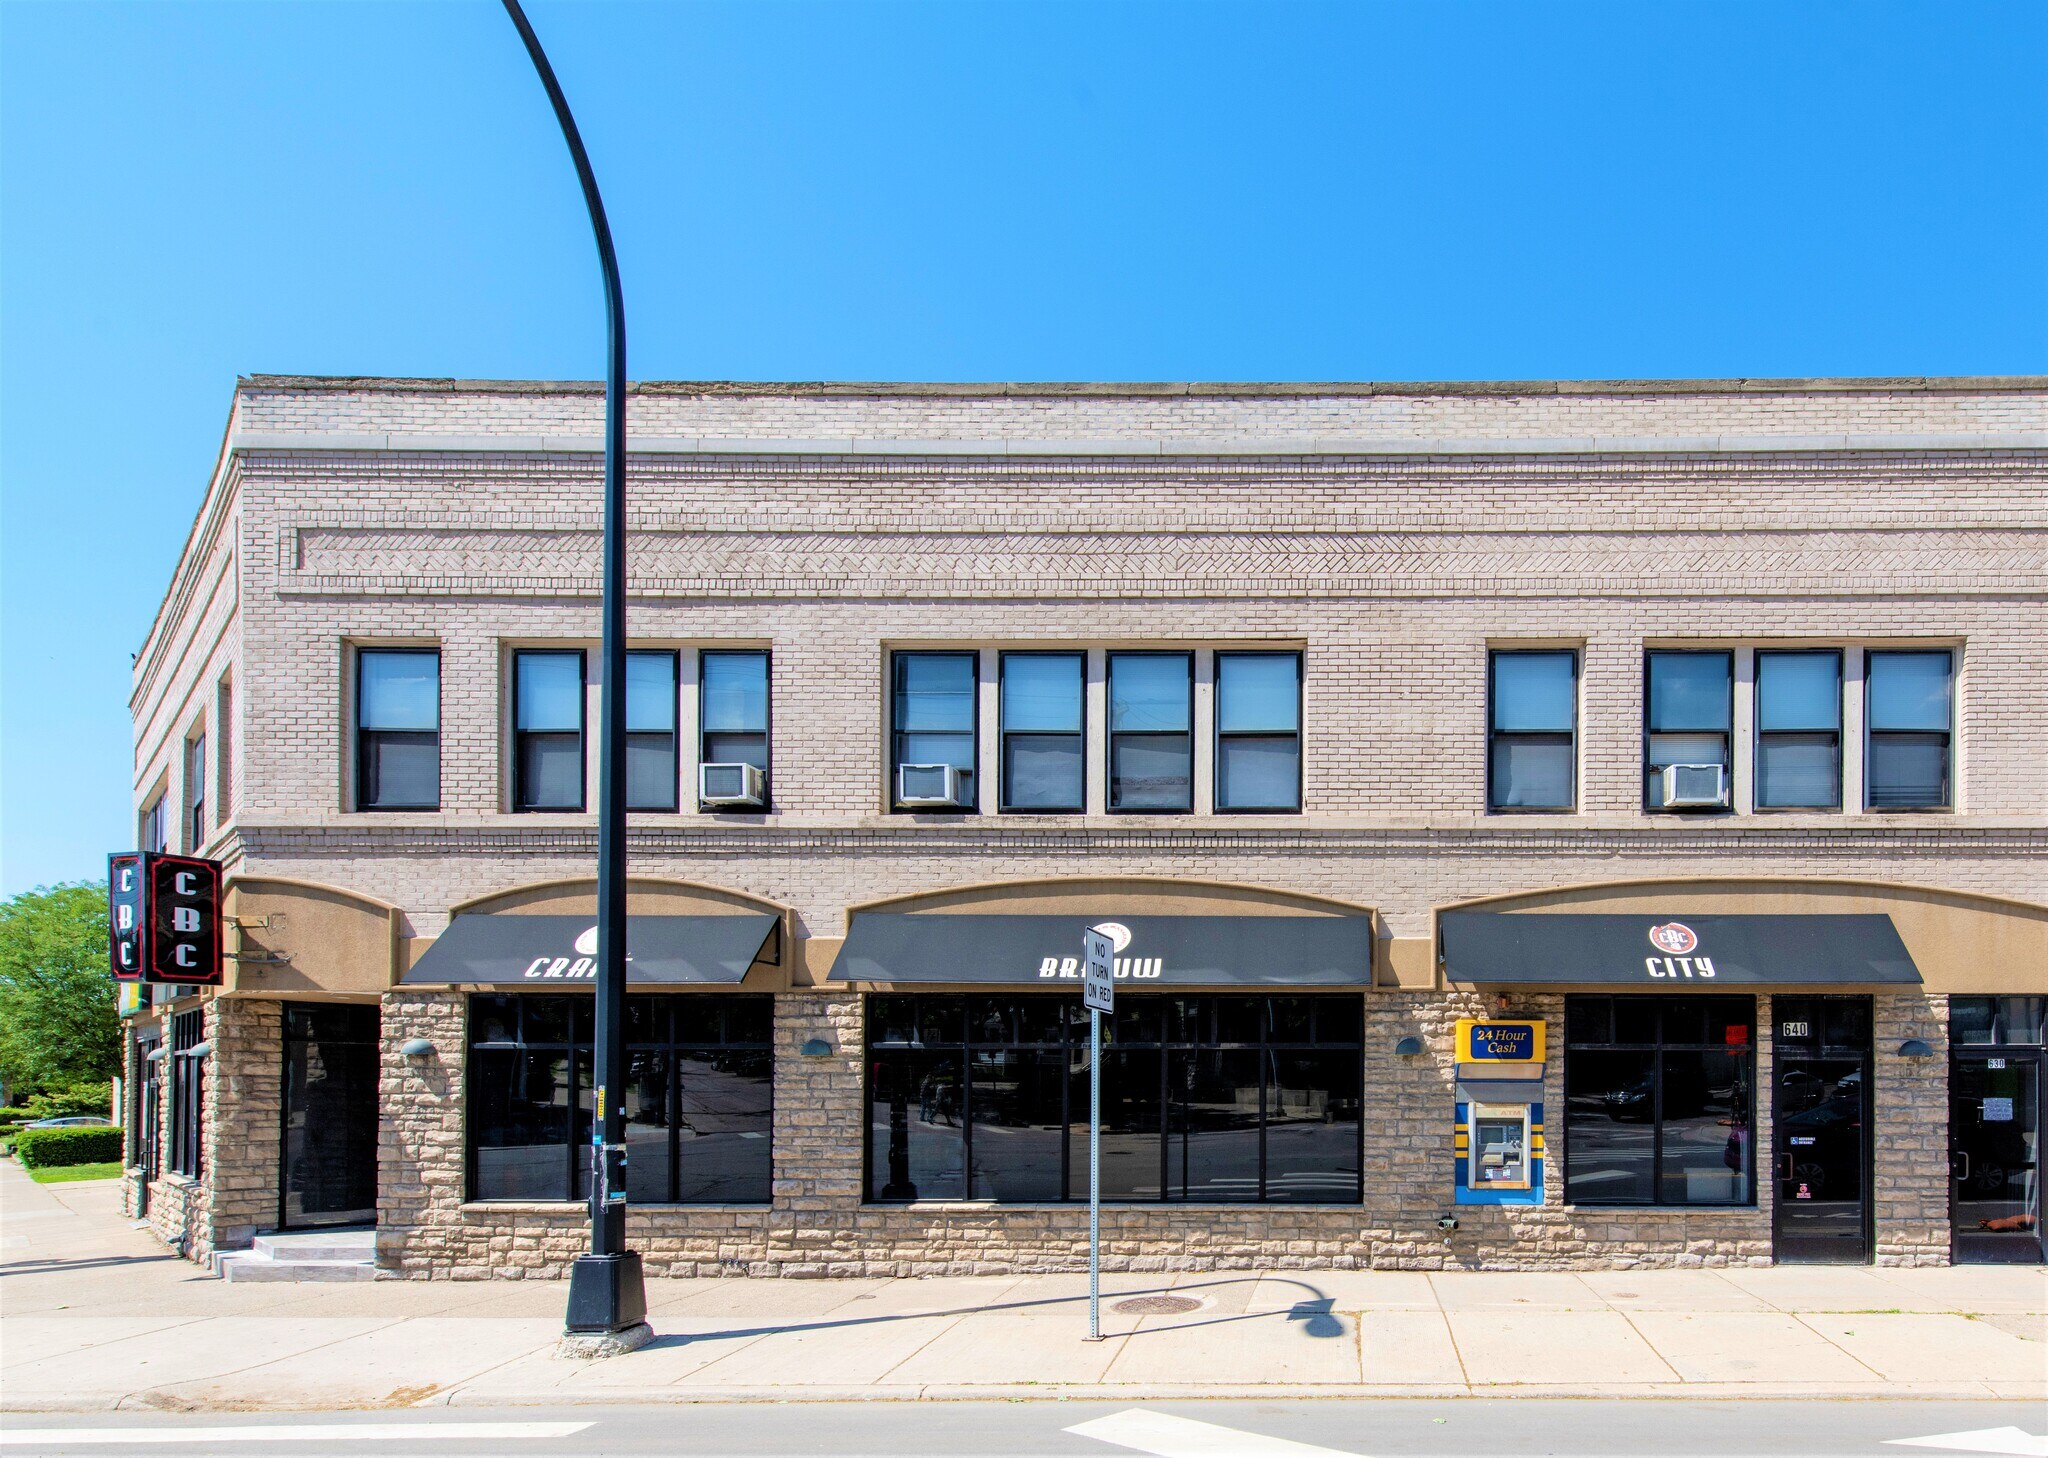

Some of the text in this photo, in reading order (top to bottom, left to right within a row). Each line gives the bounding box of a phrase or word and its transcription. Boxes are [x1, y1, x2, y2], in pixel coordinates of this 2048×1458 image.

[118, 869, 133, 966] CBC
[172, 872, 200, 967] CBC
[1658, 929, 1688, 943] CBC
[1094, 941, 1106, 958] NO
[1091, 961, 1109, 981] TURN
[1645, 957, 1716, 978] CITY
[1087, 982, 1112, 1003] ON RED
[1476, 1030, 1527, 1041] 24 Hour
[1784, 1023, 1807, 1036] 640
[1487, 1042, 1517, 1053] Cash
